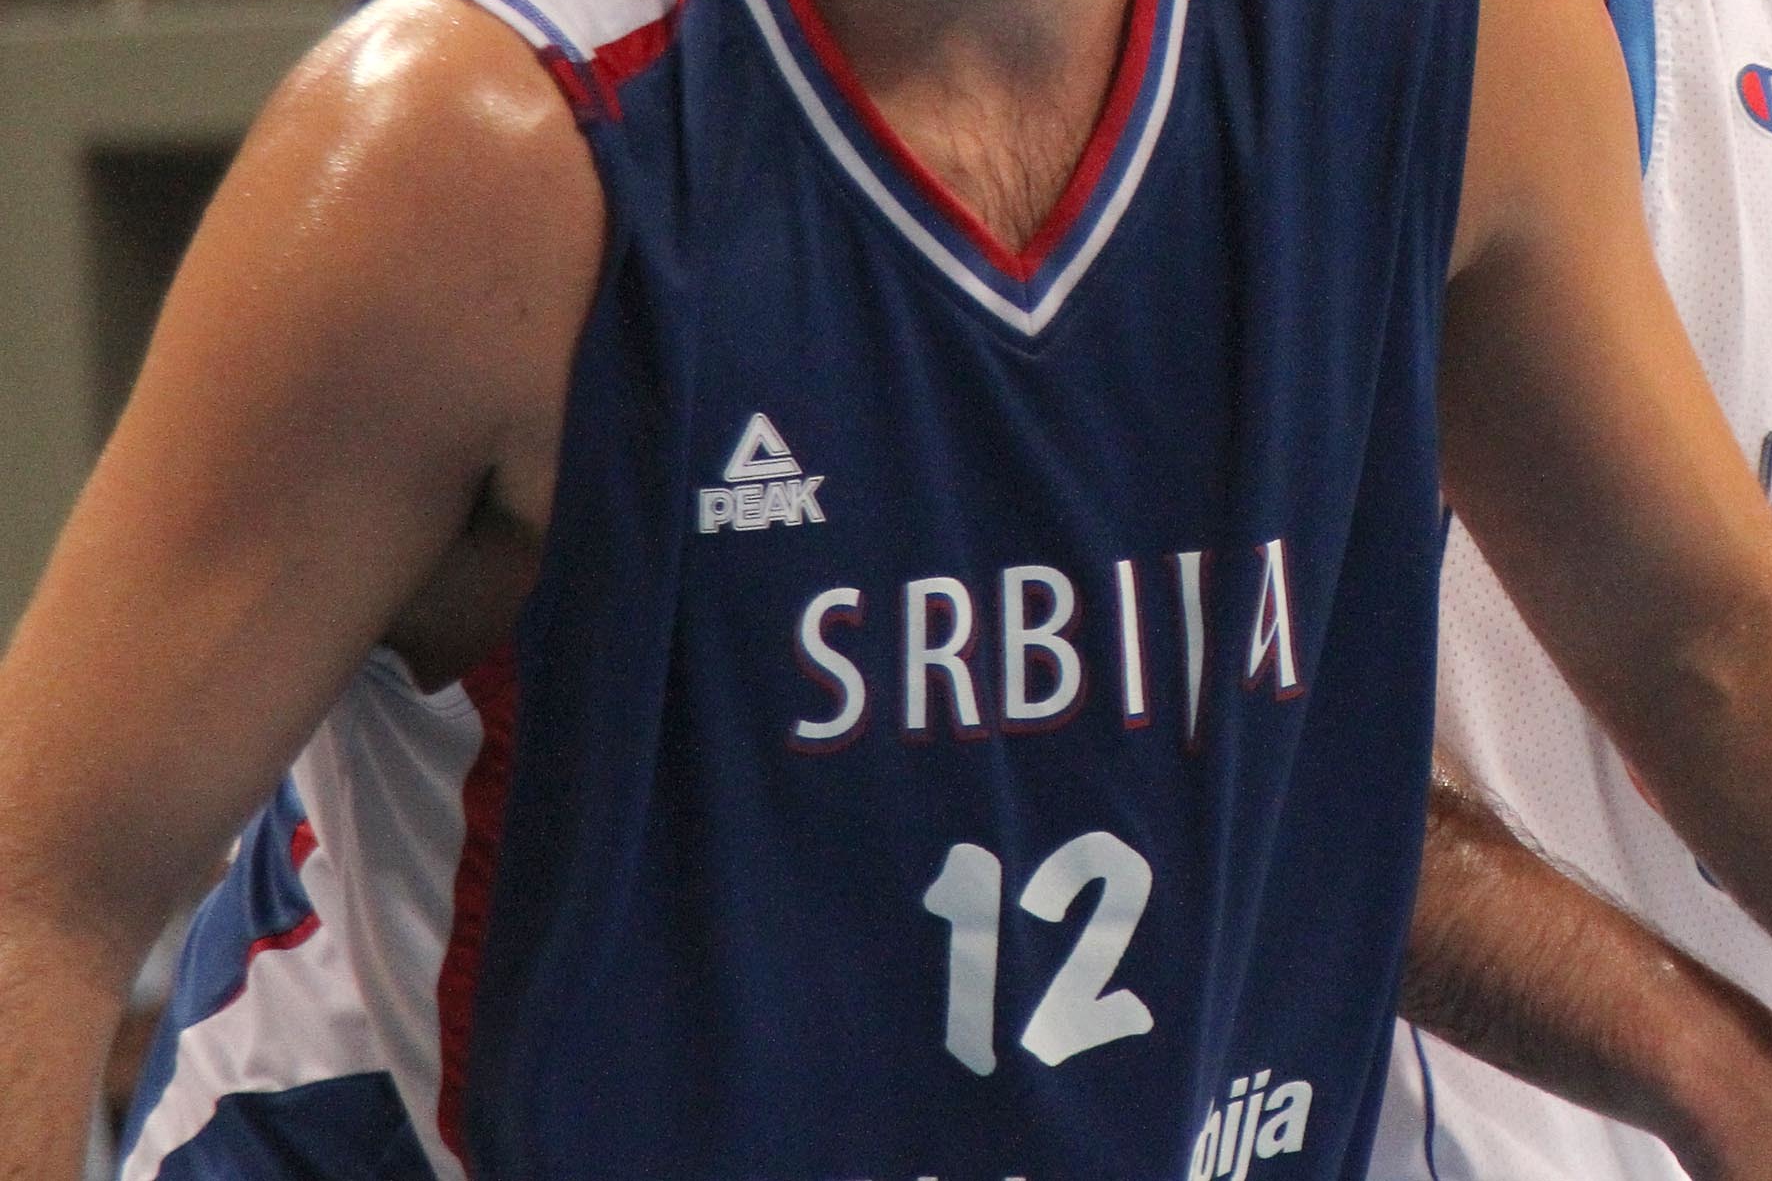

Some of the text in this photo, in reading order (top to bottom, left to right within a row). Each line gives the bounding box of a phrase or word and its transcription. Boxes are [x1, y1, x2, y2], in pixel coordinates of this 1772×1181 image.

[699, 475, 826, 533] PEAK
[789, 538, 1303, 751] SRBIJA
[923, 831, 1154, 1076] 12
